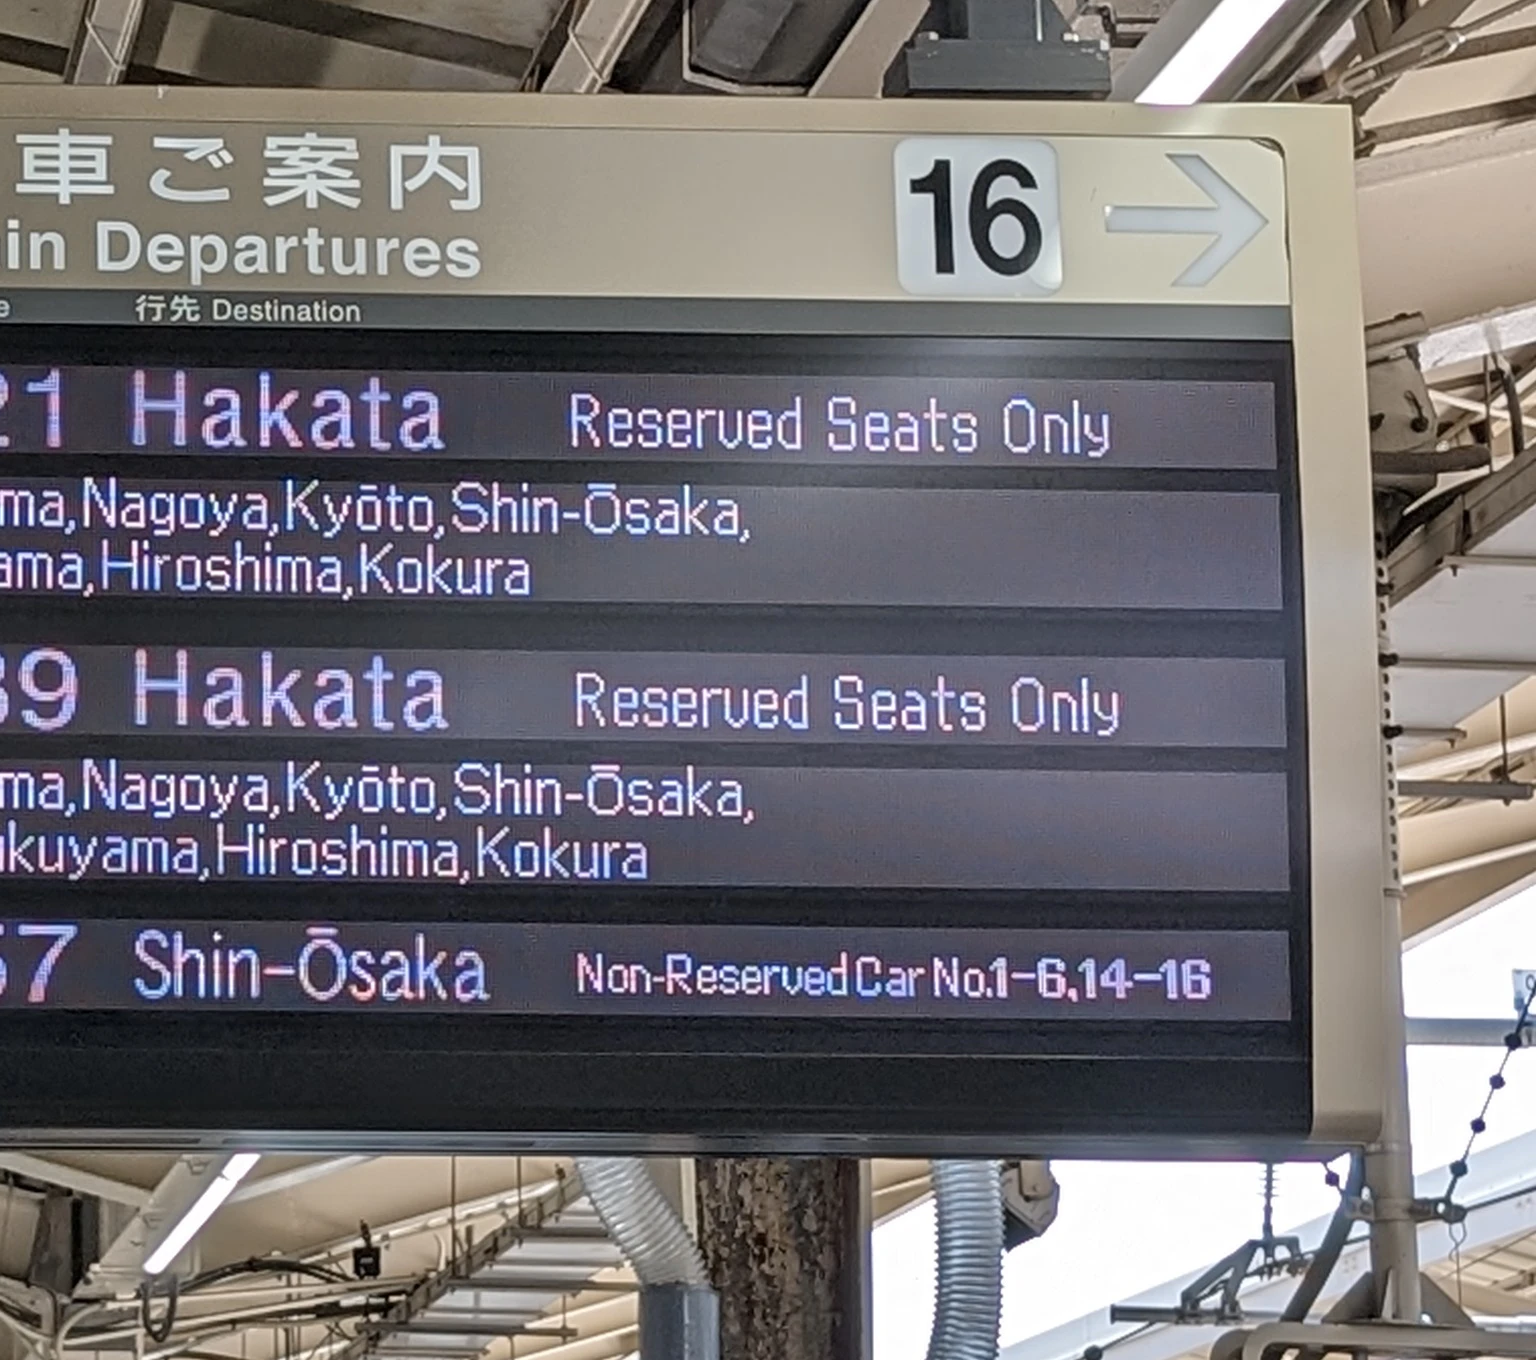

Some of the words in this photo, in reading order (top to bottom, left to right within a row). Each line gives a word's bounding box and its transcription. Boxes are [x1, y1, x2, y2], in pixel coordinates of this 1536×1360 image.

[96, 220, 482, 285] Departures
[909, 158, 1043, 277] 16
[135, 295, 201, 323] 行先
[211, 299, 362, 323] Destination
[131, 370, 446, 451] Hakata
[570, 393, 803, 452] Reserved
[826, 397, 979, 454] Seats
[1002, 398, 1111, 458] Only
[359, 541, 531, 596] Kokura
[133, 648, 449, 732] Hakata
[575, 671, 809, 731] Reserved
[834, 675, 987, 733] Seats
[1011, 676, 1121, 737] Only
[477, 826, 649, 880] Kokura
[134, 926, 491, 1001] Shin-Ōsaka
[576, 950, 850, 997] Non-Reserved
[855, 956, 926, 998] Car
